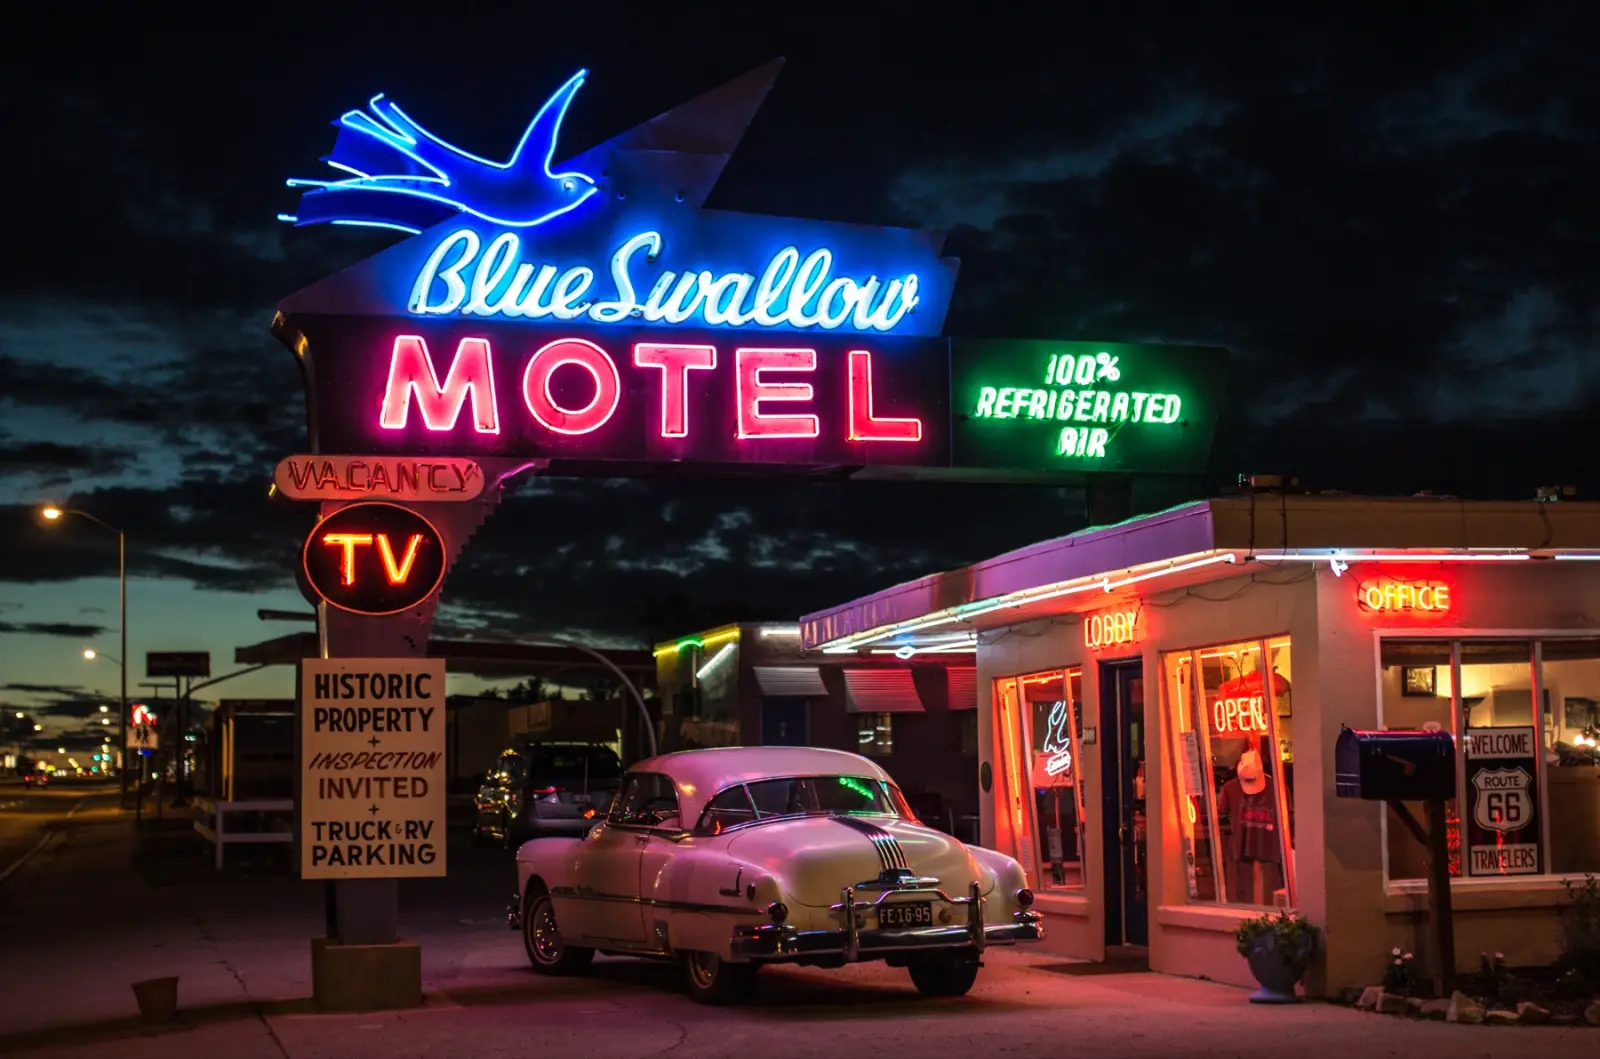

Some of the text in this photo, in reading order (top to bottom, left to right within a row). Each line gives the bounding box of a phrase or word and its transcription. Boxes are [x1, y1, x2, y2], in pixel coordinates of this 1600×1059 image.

[407, 228, 919, 331] Blue Swallow
[1045, 352, 1121, 386] 100%
[379, 334, 922, 442] MOTEL
[975, 386, 1182, 424] REFRIGERATED
[1056, 426, 1109, 457] AIR
[288, 460, 480, 494] VACANCY
[322, 533, 424, 585] TV
[1366, 585, 1449, 610] OFFICE
[1084, 611, 1138, 648] LOBBY
[314, 673, 432, 700] HISTORIC
[314, 707, 436, 732] PROPERTY
[1214, 696, 1266, 732] OPEN
[1470, 733, 1530, 755] WELCOME
[308, 751, 442, 770] INSPECTION
[319, 776, 429, 799] INVITED
[1484, 776, 1520, 787] ROUTE
[1487, 792, 1521, 822] 66
[311, 820, 434, 841] TRUCK & RV
[312, 844, 436, 866] PARKING
[1473, 848, 1536, 870] TRAVELERS
